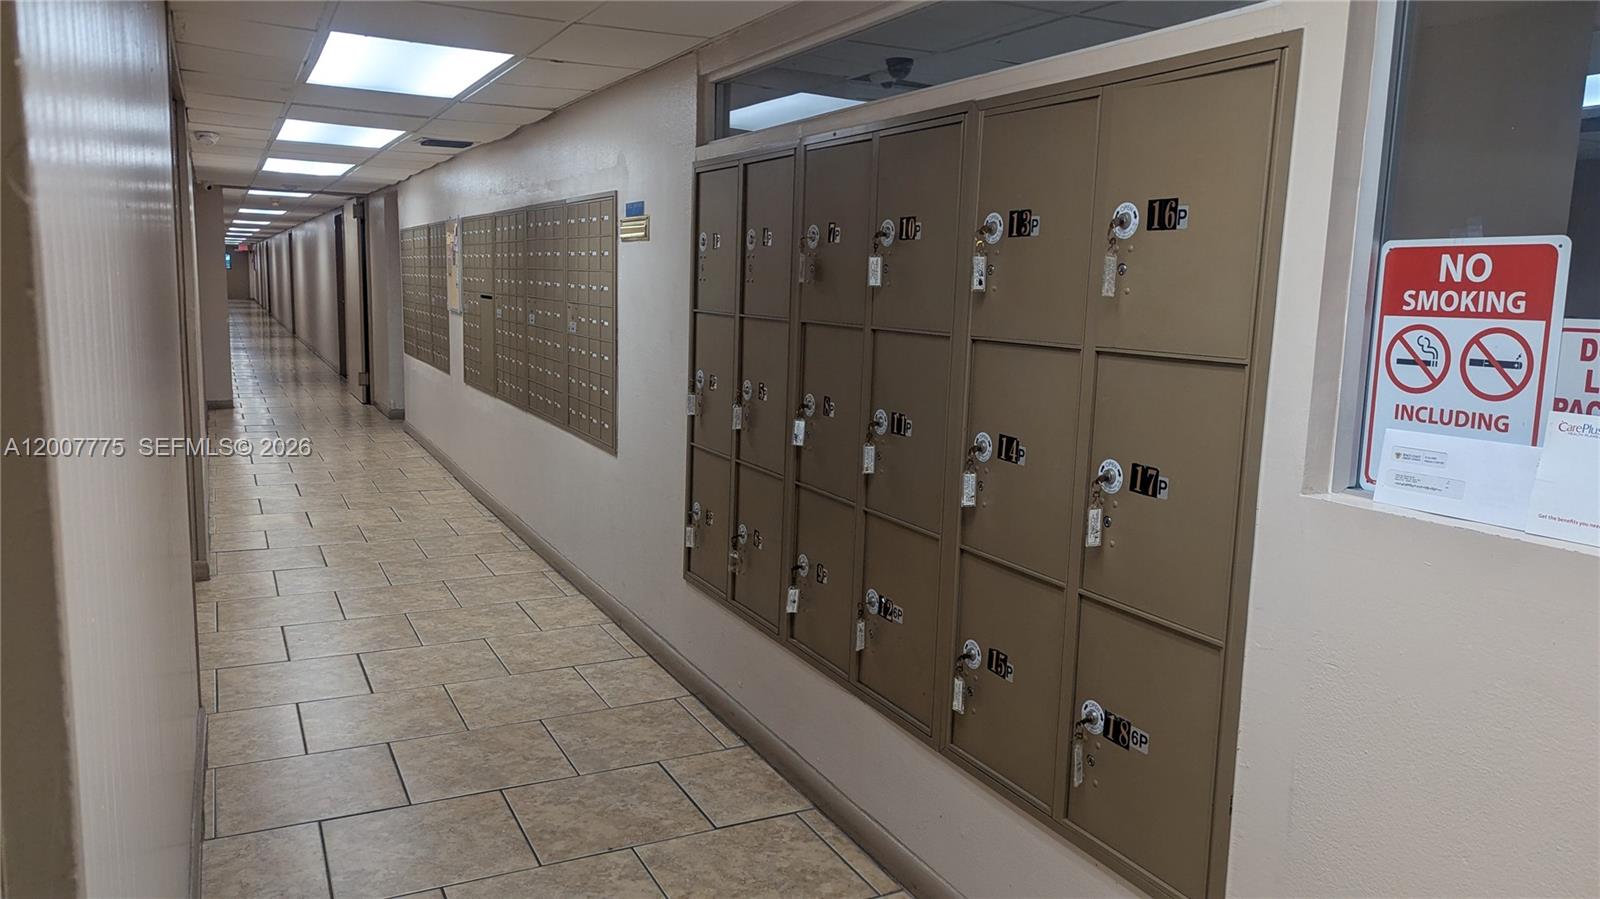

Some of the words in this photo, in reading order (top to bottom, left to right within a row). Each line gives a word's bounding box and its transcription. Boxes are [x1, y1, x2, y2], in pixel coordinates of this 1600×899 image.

[1439, 253, 1493, 283] NO
[1402, 290, 1527, 314] SMOKING
[1580, 338, 1600, 361] D
[1394, 404, 1510, 433] INCLUDING
